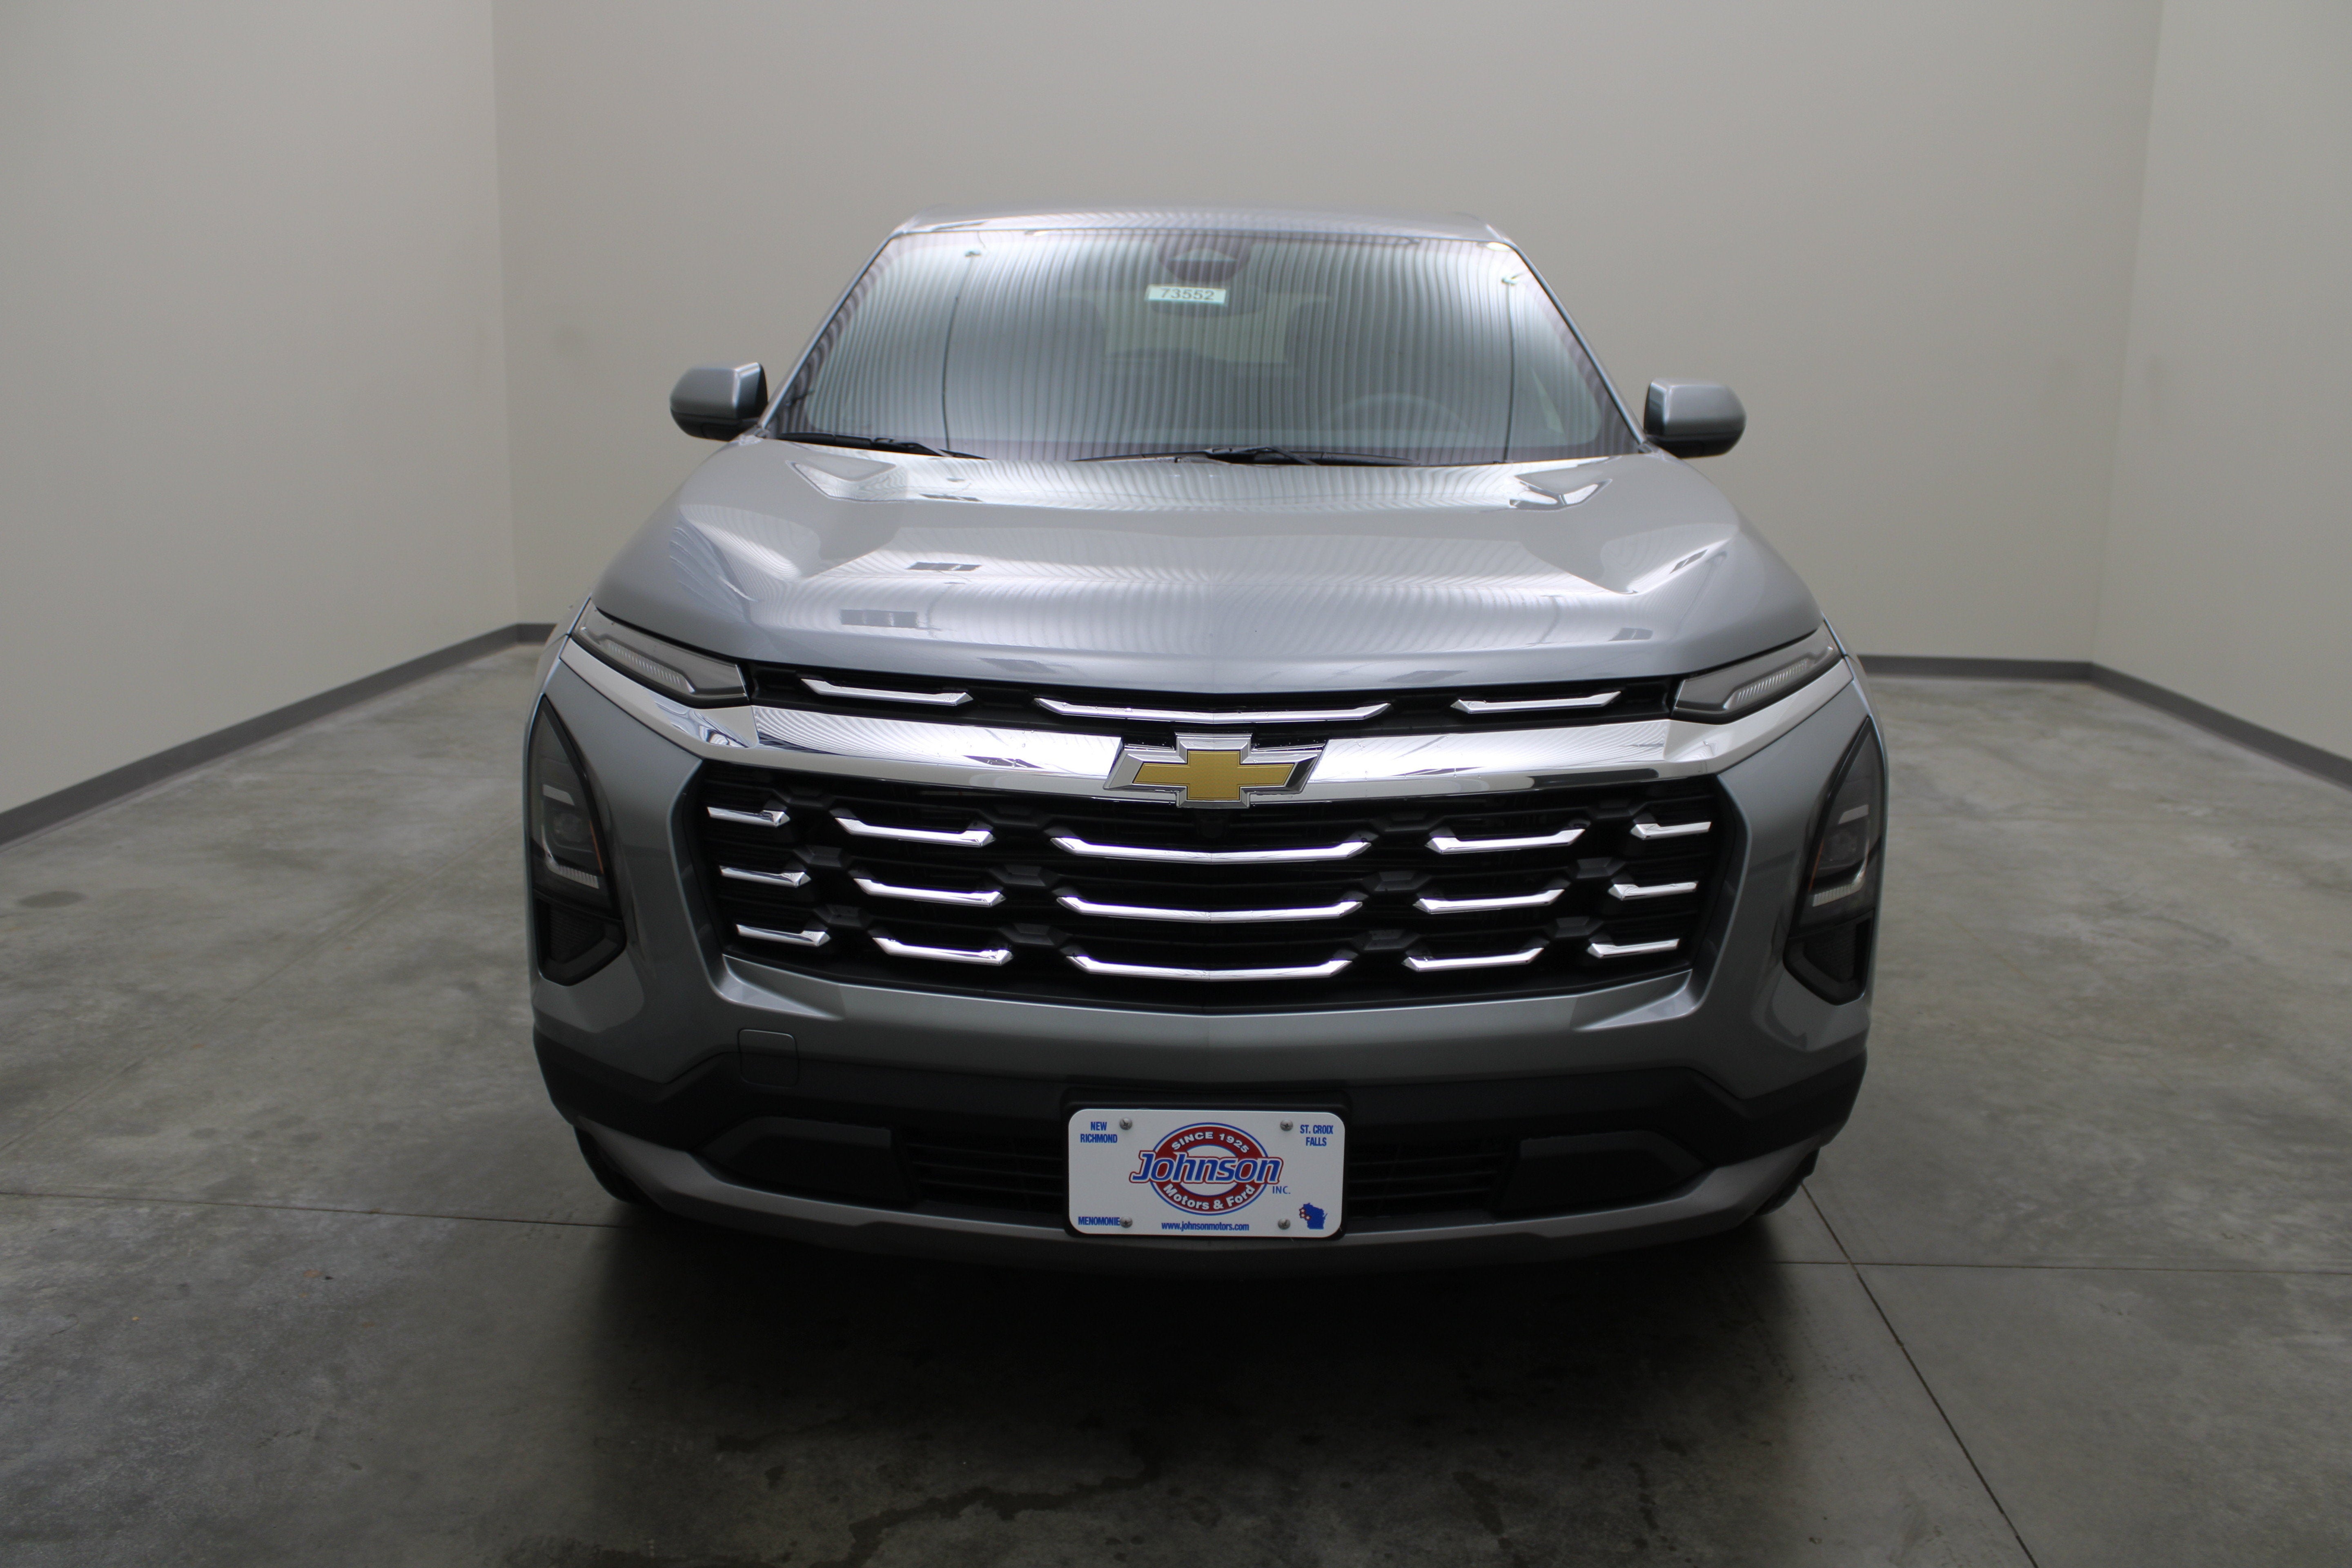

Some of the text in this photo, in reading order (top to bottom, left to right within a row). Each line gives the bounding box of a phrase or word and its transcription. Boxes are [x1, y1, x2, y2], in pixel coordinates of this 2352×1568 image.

[1160, 287, 1214, 301] 73552
[1090, 1121, 1107, 1131] NEW
[1300, 1124, 1334, 1134] ST. CROIX
[1080, 1134, 1118, 1143] RICHMOND
[1171, 1131, 1250, 1153] SINCE 1925
[1306, 1137, 1327, 1146] FALLS
[1130, 1152, 1283, 1183] Johnson
[1272, 1186, 1291, 1194] INC.
[1163, 1183, 1256, 1210] Motors & Ford
[1078, 1216, 1120, 1225] MENOMONIE
[1161, 1221, 1250, 1231] www.johnsonmotors.com
